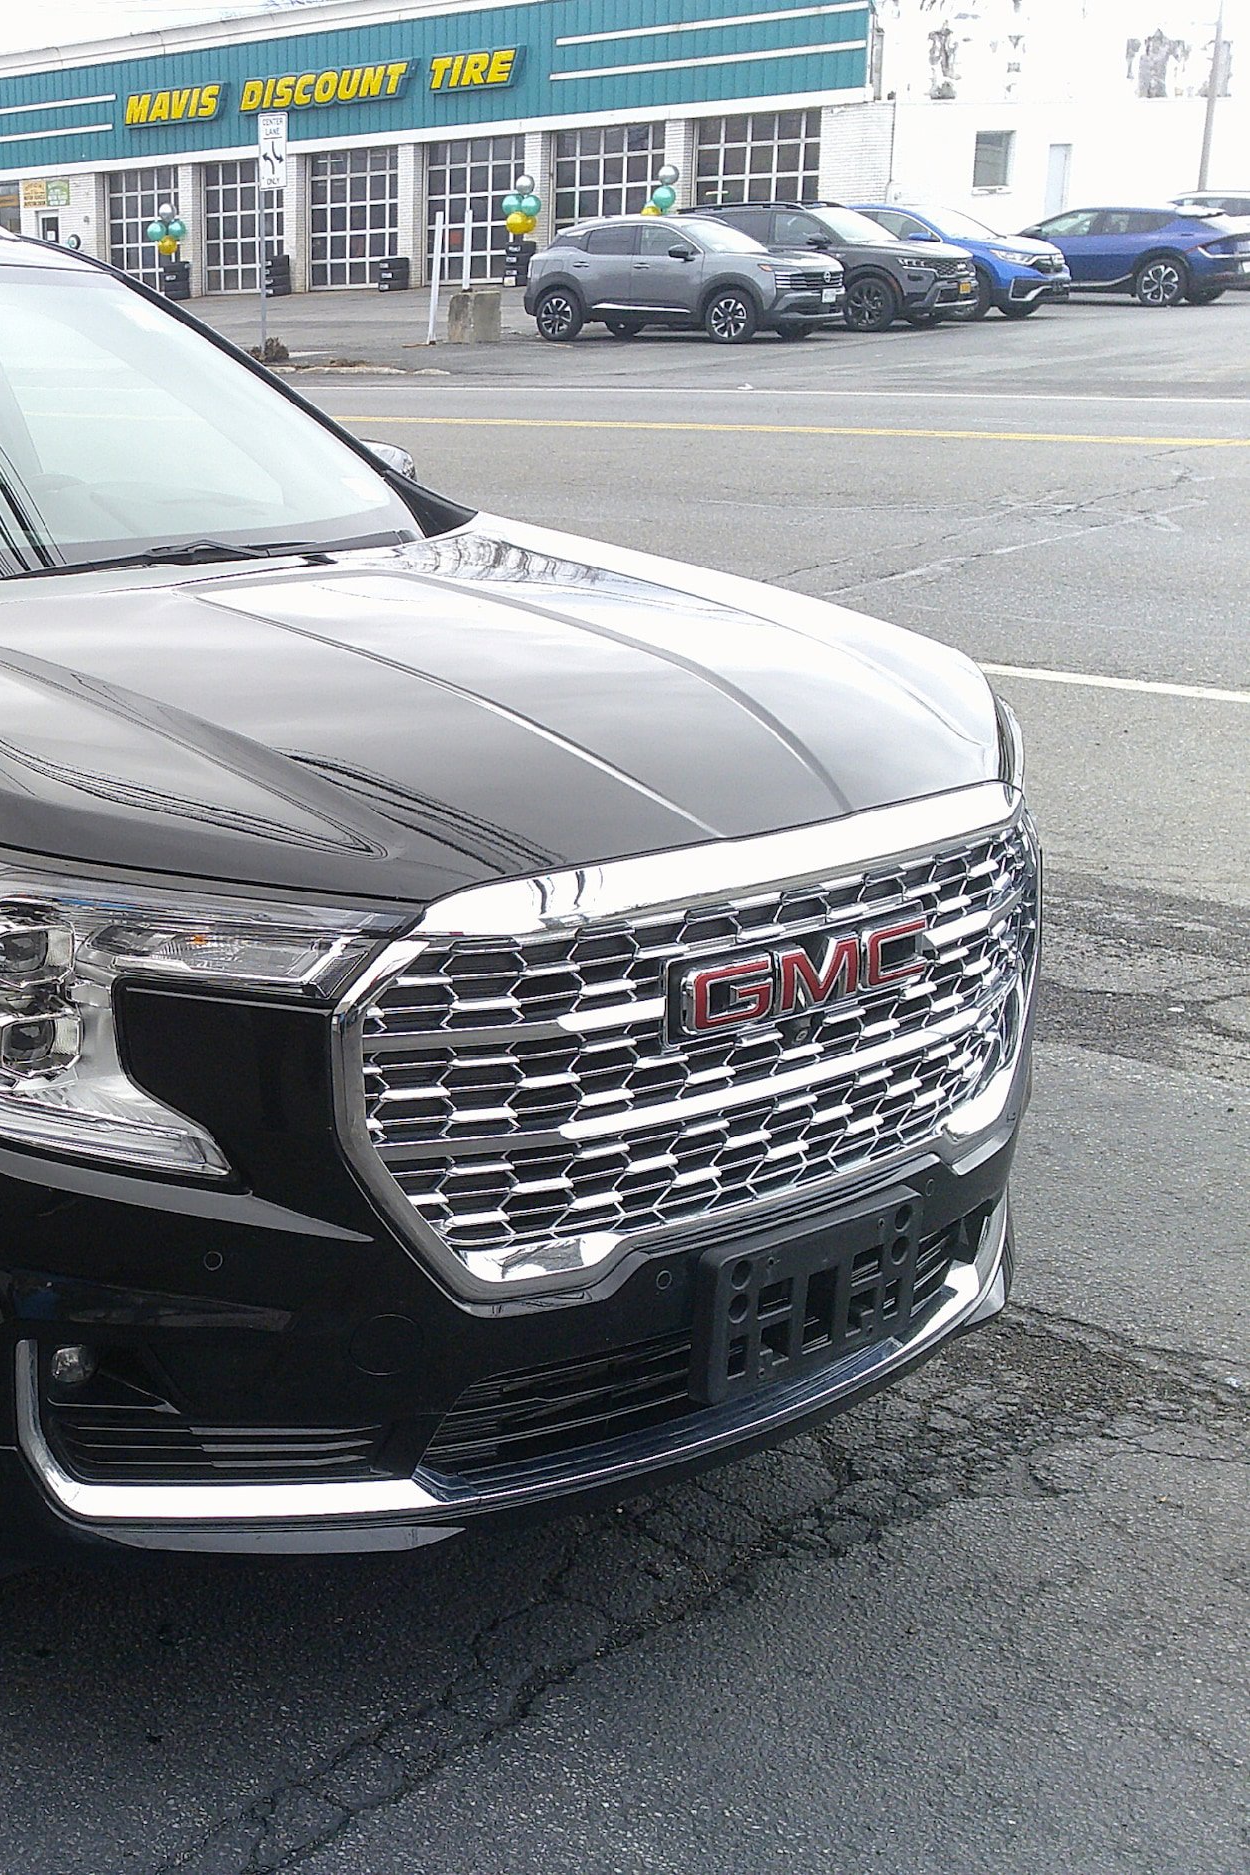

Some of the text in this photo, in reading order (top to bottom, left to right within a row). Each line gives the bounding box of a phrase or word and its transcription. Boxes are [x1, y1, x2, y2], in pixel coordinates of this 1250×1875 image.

[126, 48, 518, 127] MAVIS DISCOUNT TIRE
[262, 118, 283, 126] CENTER
[265, 128, 280, 136] LANE
[266, 178, 281, 186] ONLY
[686, 917, 928, 1033] GMC
